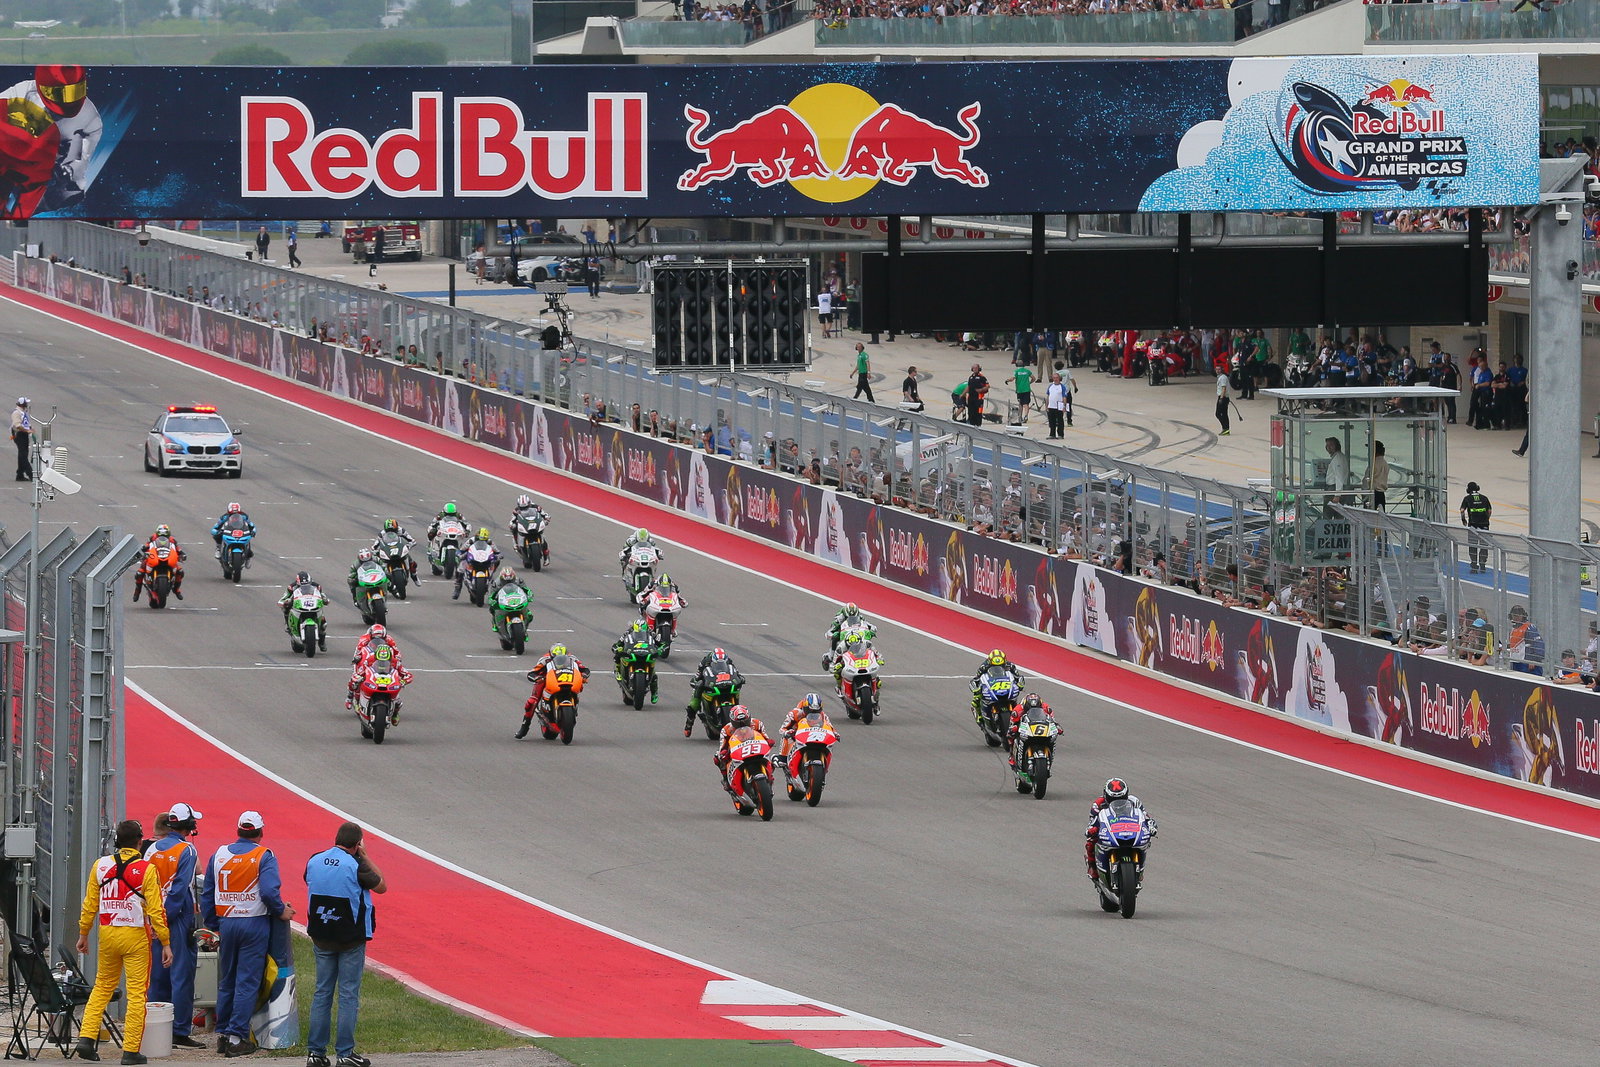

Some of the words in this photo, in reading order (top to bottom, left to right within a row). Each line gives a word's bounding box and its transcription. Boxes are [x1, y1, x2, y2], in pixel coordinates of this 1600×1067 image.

[1353, 110, 1399, 135] Red
[1400, 110, 1445, 134] Bull
[241, 92, 443, 198] Red
[454, 92, 648, 198] Bull
[1348, 141, 1415, 154] GRAND
[1420, 140, 1463, 153] PRIX
[1389, 154, 1408, 162] THE
[1367, 161, 1463, 176] AMERICAS
[911, 223, 919, 234] 10
[1323, 523, 1351, 535] STAR
[1317, 537, 1351, 549] DELAY
[1170, 612, 1185, 660] Red
[1185, 617, 1200, 665] Bull
[557, 673, 573, 683] 41
[990, 681, 1011, 690] 46
[1420, 681, 1440, 735] Red
[1439, 686, 1459, 740] Bull
[1035, 725, 1046, 735] 6
[742, 745, 761, 758] 93
[324, 857, 340, 867] 092
[220, 870, 232, 891] T
[103, 878, 119, 899] M
[219, 892, 256, 902] AMERICAS
